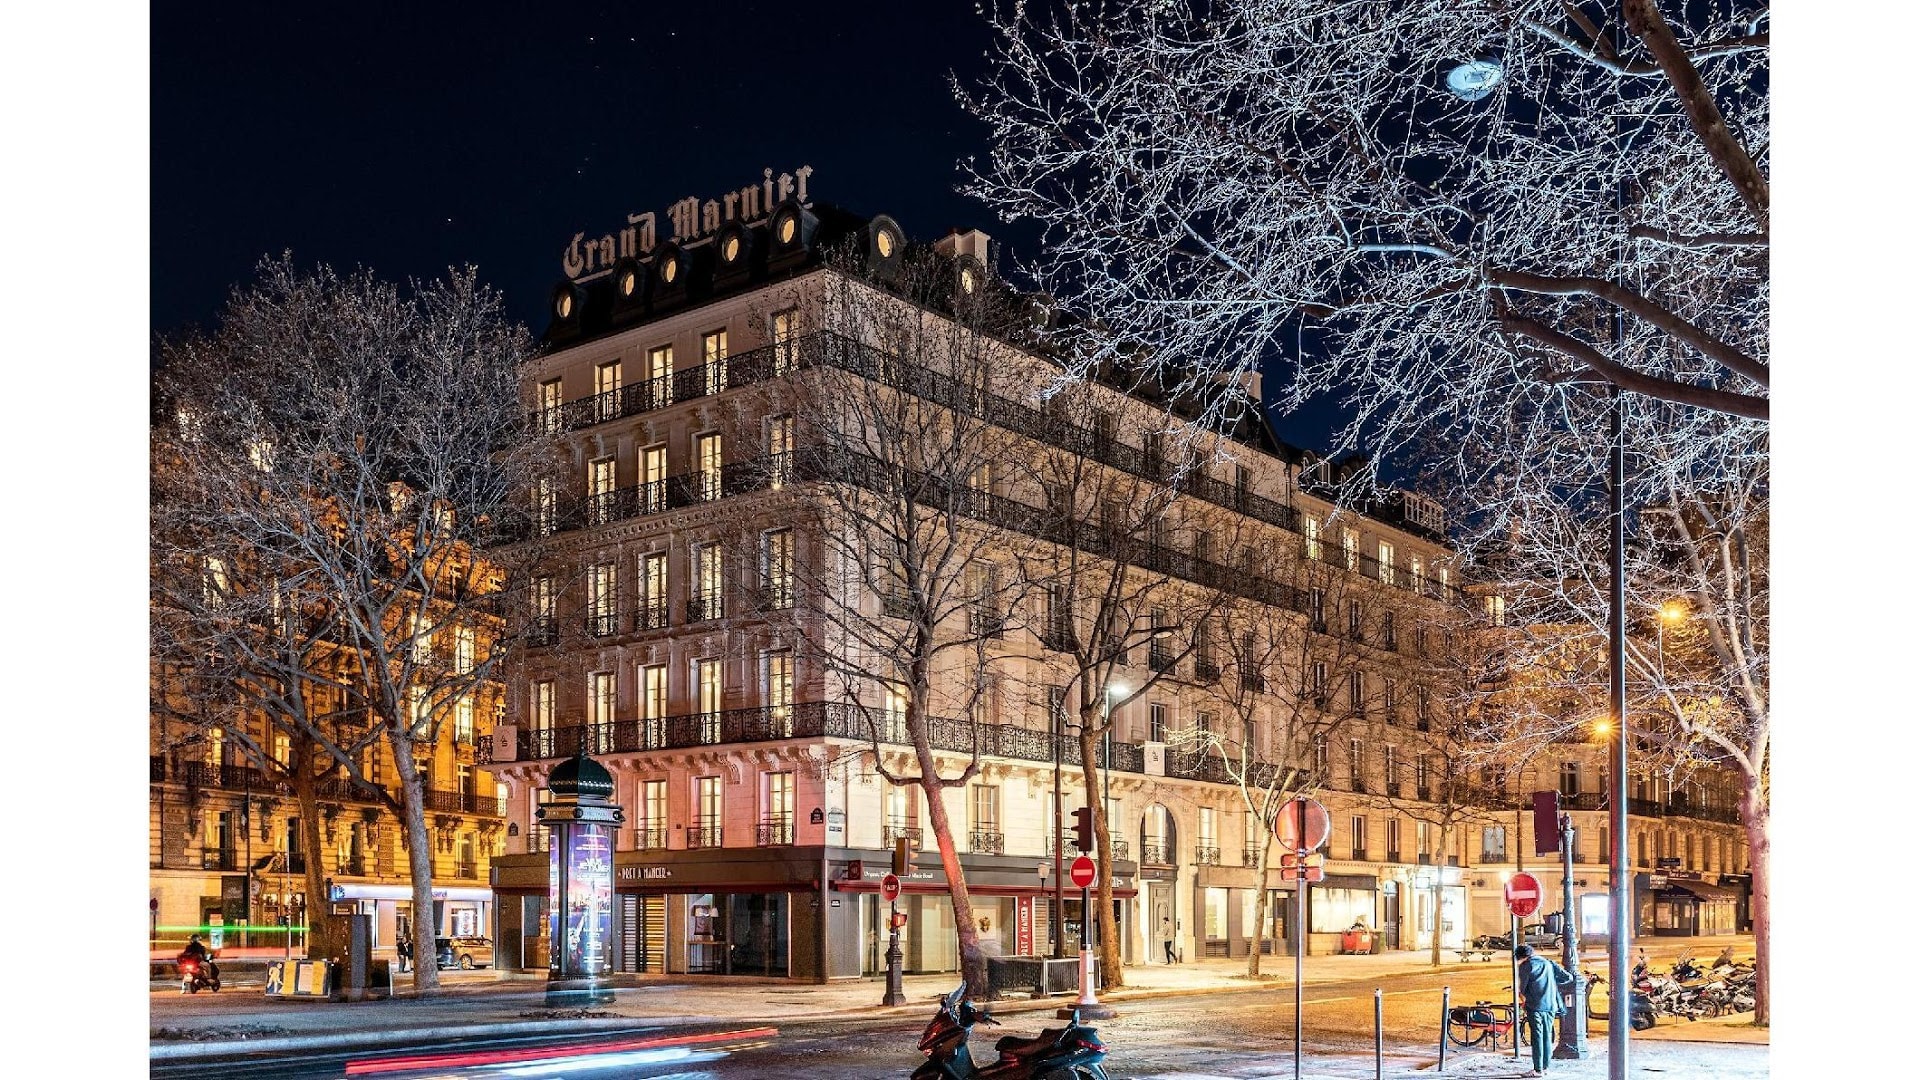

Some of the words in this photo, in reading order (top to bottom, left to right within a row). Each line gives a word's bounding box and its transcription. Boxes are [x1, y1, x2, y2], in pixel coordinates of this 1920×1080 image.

[563, 211, 656, 279] Grand
[667, 165, 813, 241] Marnier
[643, 867, 666, 879] MANGER
